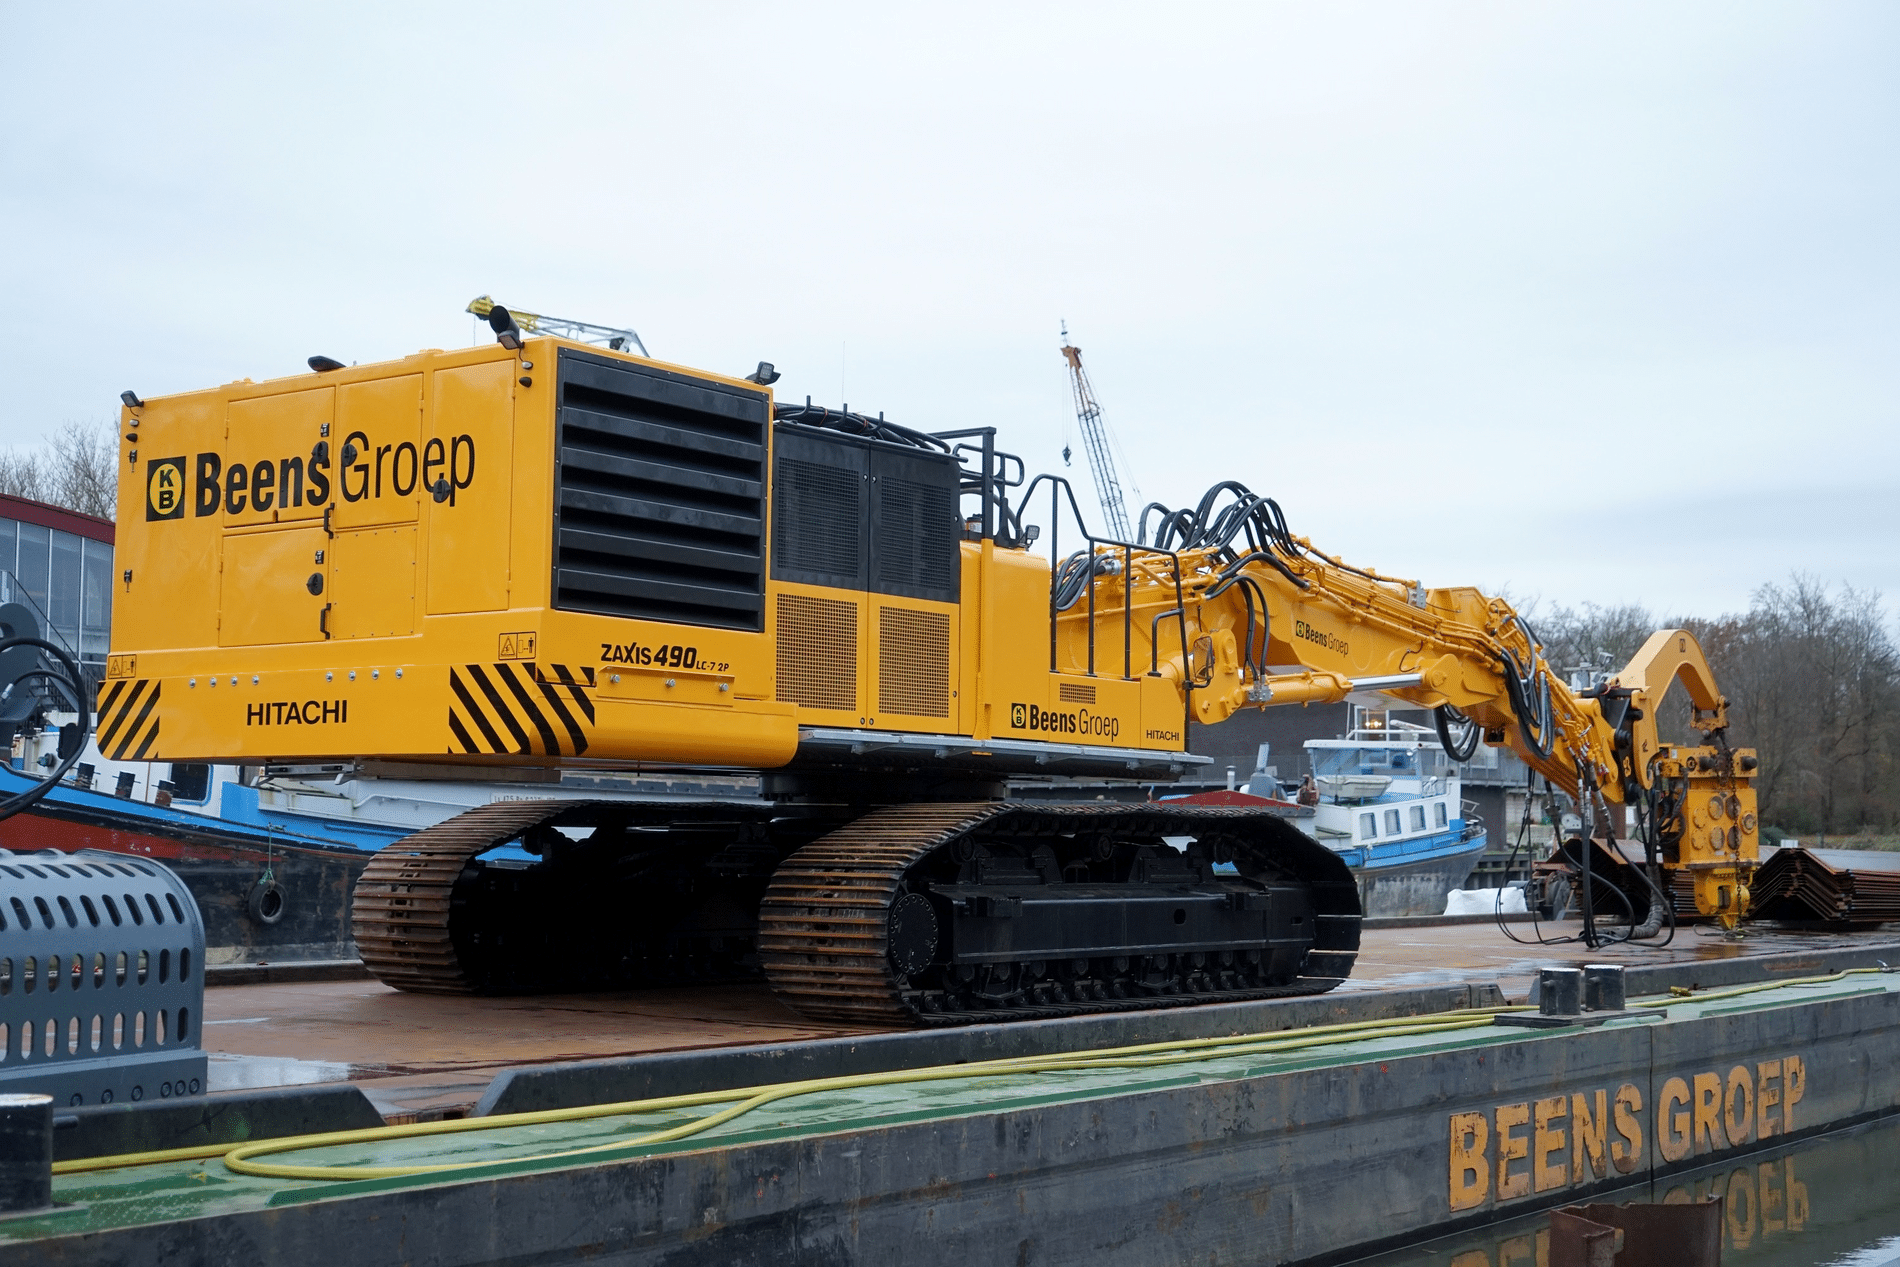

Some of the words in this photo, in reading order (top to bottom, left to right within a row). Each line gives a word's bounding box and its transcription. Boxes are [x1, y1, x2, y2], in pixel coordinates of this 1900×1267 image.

[195, 452, 331, 518] Beens
[340, 431, 475, 507] Groep
[1305, 623, 1327, 648] Beens
[1328, 632, 1349, 658] Groep
[246, 700, 348, 726] HITACHI
[1029, 704, 1076, 733] Beens
[1079, 708, 1119, 742] Groep
[1146, 729, 1179, 742] HITACHI
[1449, 1083, 1643, 1213] BEENS
[1658, 1055, 1806, 1163] GROEP
